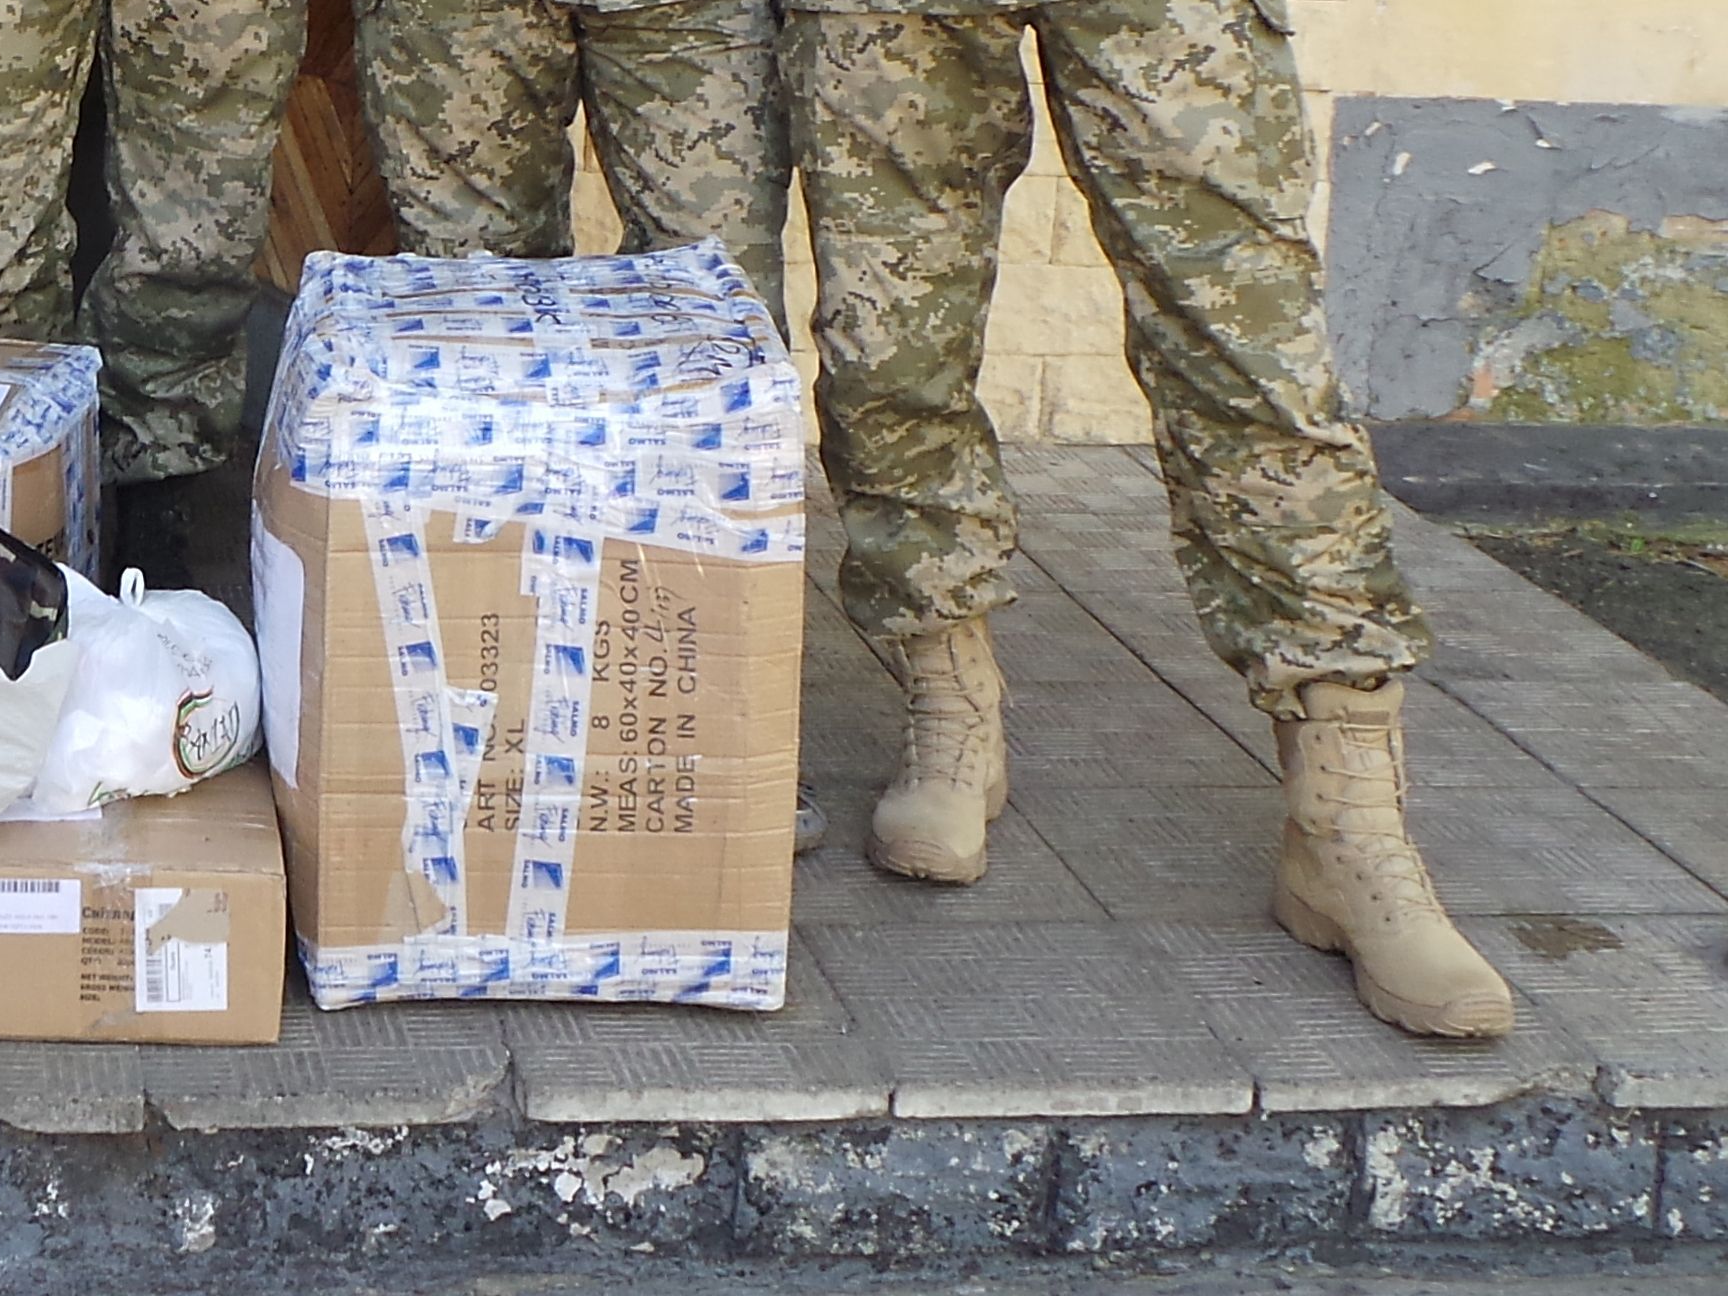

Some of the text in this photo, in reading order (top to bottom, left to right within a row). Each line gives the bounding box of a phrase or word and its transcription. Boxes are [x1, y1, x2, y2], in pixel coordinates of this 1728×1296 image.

[479, 612, 499, 692] 03323
[648, 647, 669, 697] NO.
[504, 718, 525, 831] SIZE: XL
[590, 620, 611, 832] N.W.: 8 KGS
[646, 716, 667, 833] CARTON
[674, 606, 697, 833] MADE IN CHINA
[476, 778, 495, 832] ART
